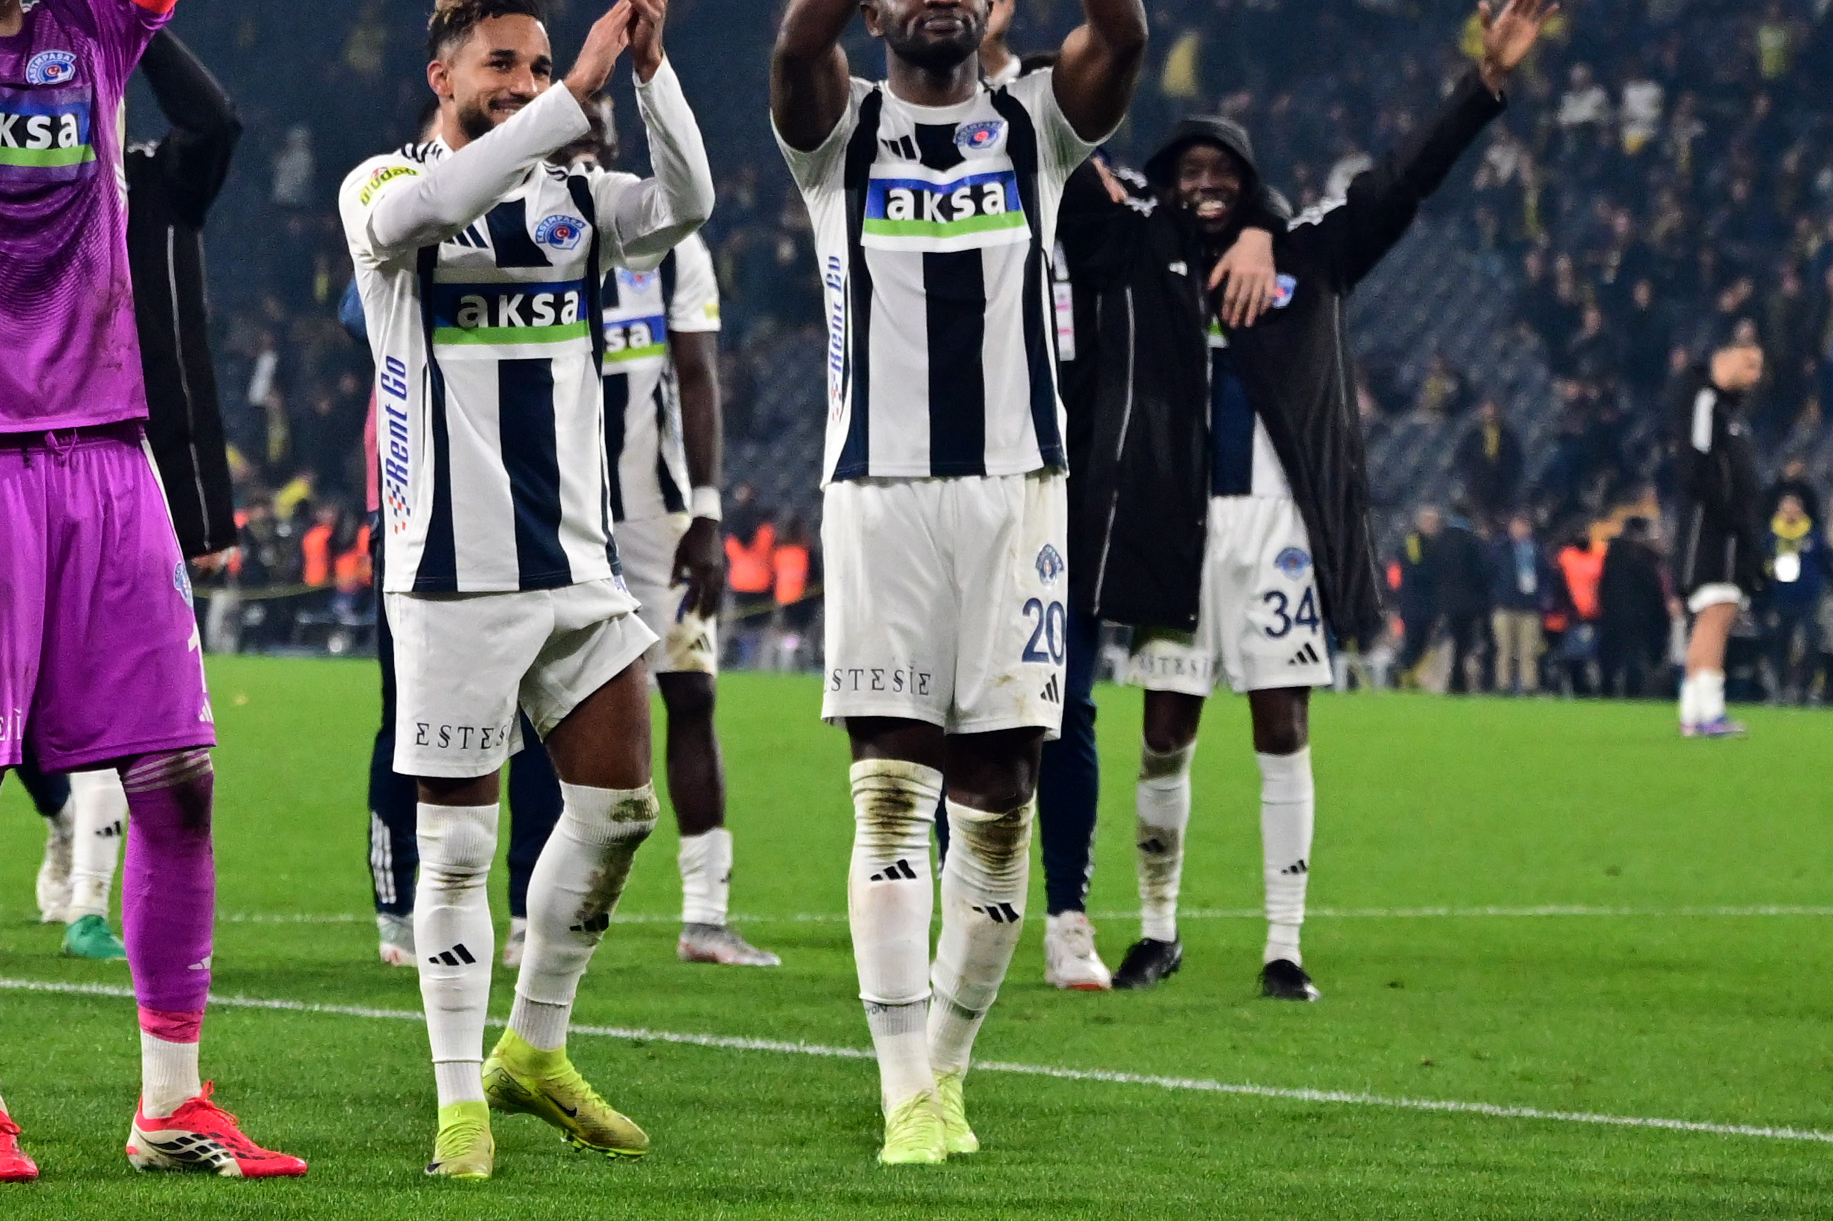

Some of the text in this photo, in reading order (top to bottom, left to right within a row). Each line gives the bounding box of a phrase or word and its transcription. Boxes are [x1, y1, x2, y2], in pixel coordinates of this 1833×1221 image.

[886, 181, 1007, 223] aksa
[457, 288, 580, 328] aksa
[604, 322, 652, 353] sa
[380, 355, 410, 487] Rent Go
[1021, 597, 1066, 667] 20
[1263, 586, 1320, 639] 34
[825, 664, 931, 696] STESİE
